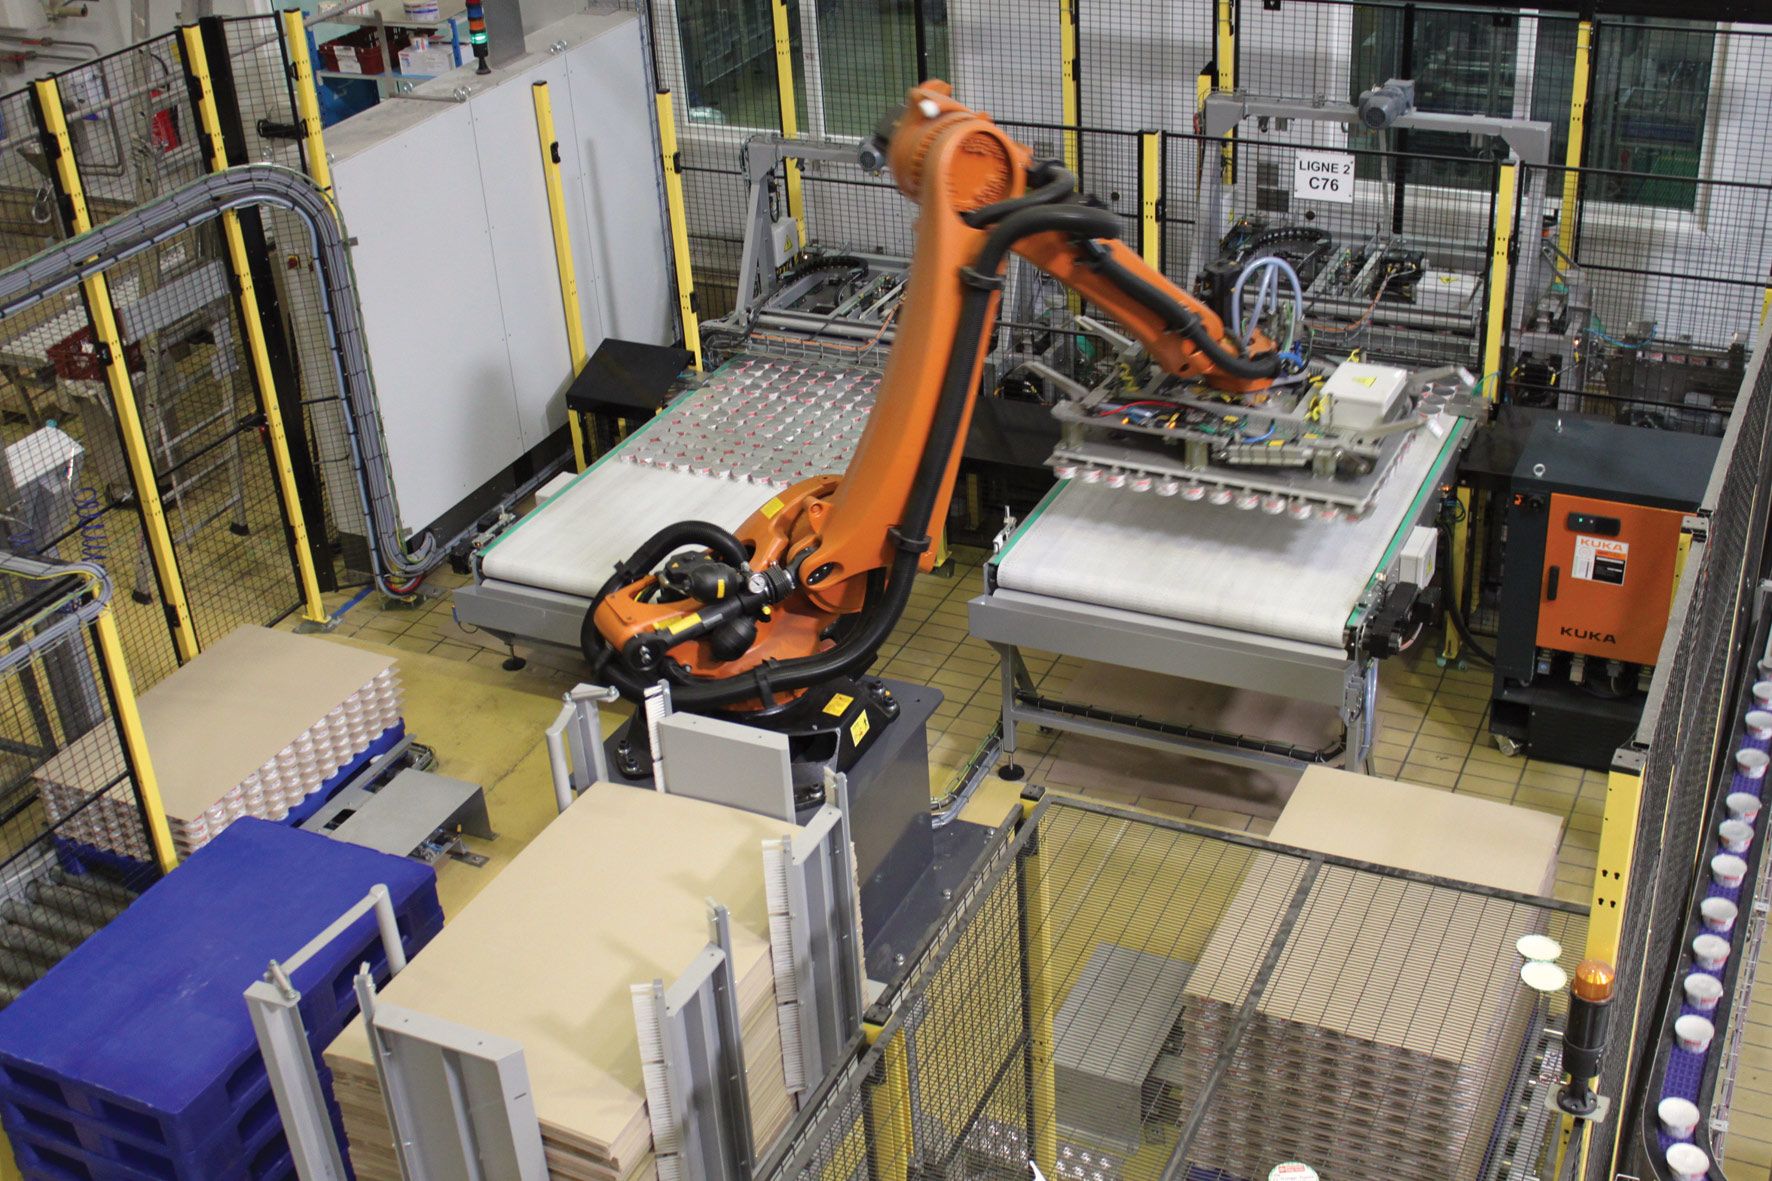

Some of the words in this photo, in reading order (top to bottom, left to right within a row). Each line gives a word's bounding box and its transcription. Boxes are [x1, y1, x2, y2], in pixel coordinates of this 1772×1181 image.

[1299, 160, 1339, 174] LIGNE
[1343, 164, 1351, 175] 2
[1309, 176, 1339, 192] C76
[1580, 538, 1623, 552] KUKA
[1560, 626, 1617, 645] KUKA
